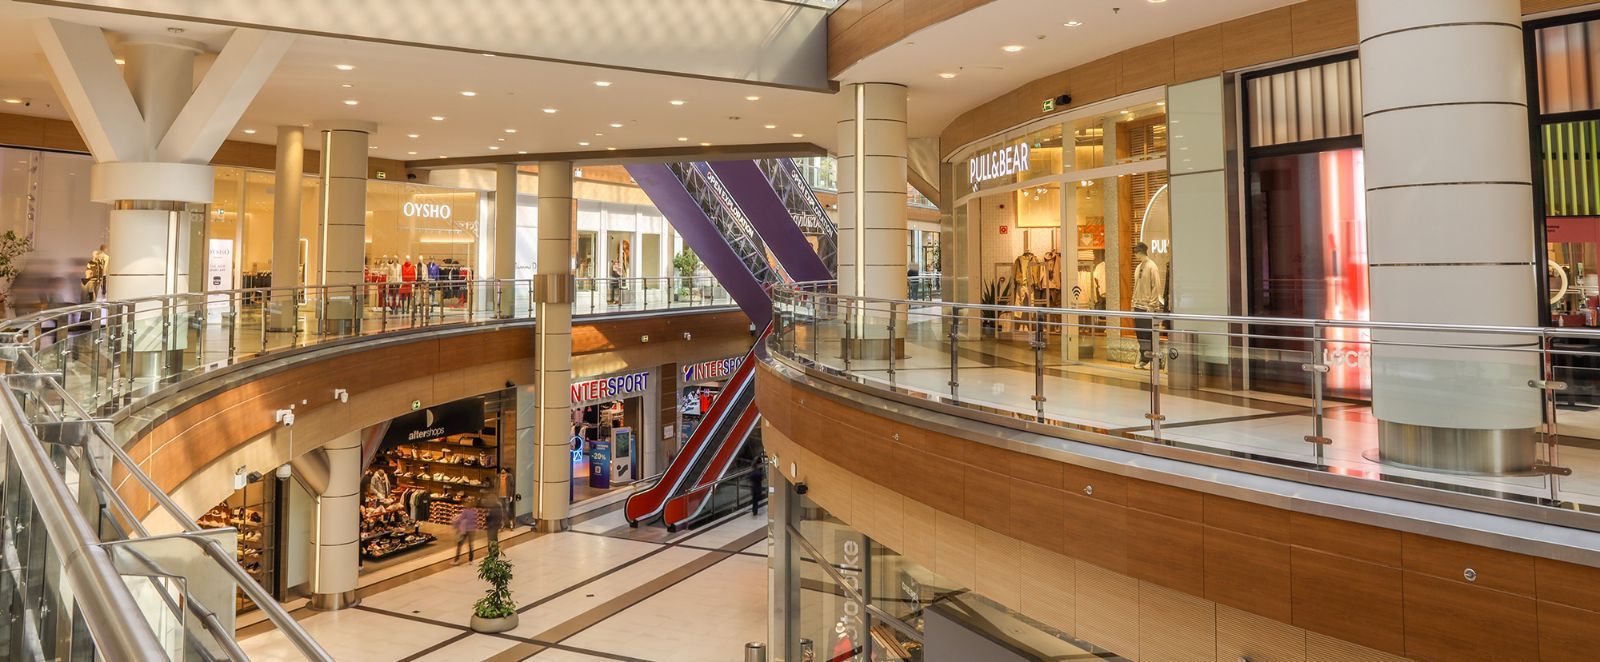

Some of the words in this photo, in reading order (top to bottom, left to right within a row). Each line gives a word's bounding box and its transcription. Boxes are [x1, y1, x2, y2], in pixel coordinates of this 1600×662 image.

[970, 142, 1029, 184] PULL&BEAR
[791, 169, 806, 194] OPEN
[403, 201, 451, 219] OYSHO
[707, 171, 722, 195] OPEN
[721, 192, 755, 238] EXPLORATION
[1151, 239, 1170, 253] PUL
[693, 356, 745, 380] INTERSPO
[570, 372, 649, 404] NTERSPORT
[408, 427, 445, 440] aftershops
[591, 452, 607, 460] -20%
